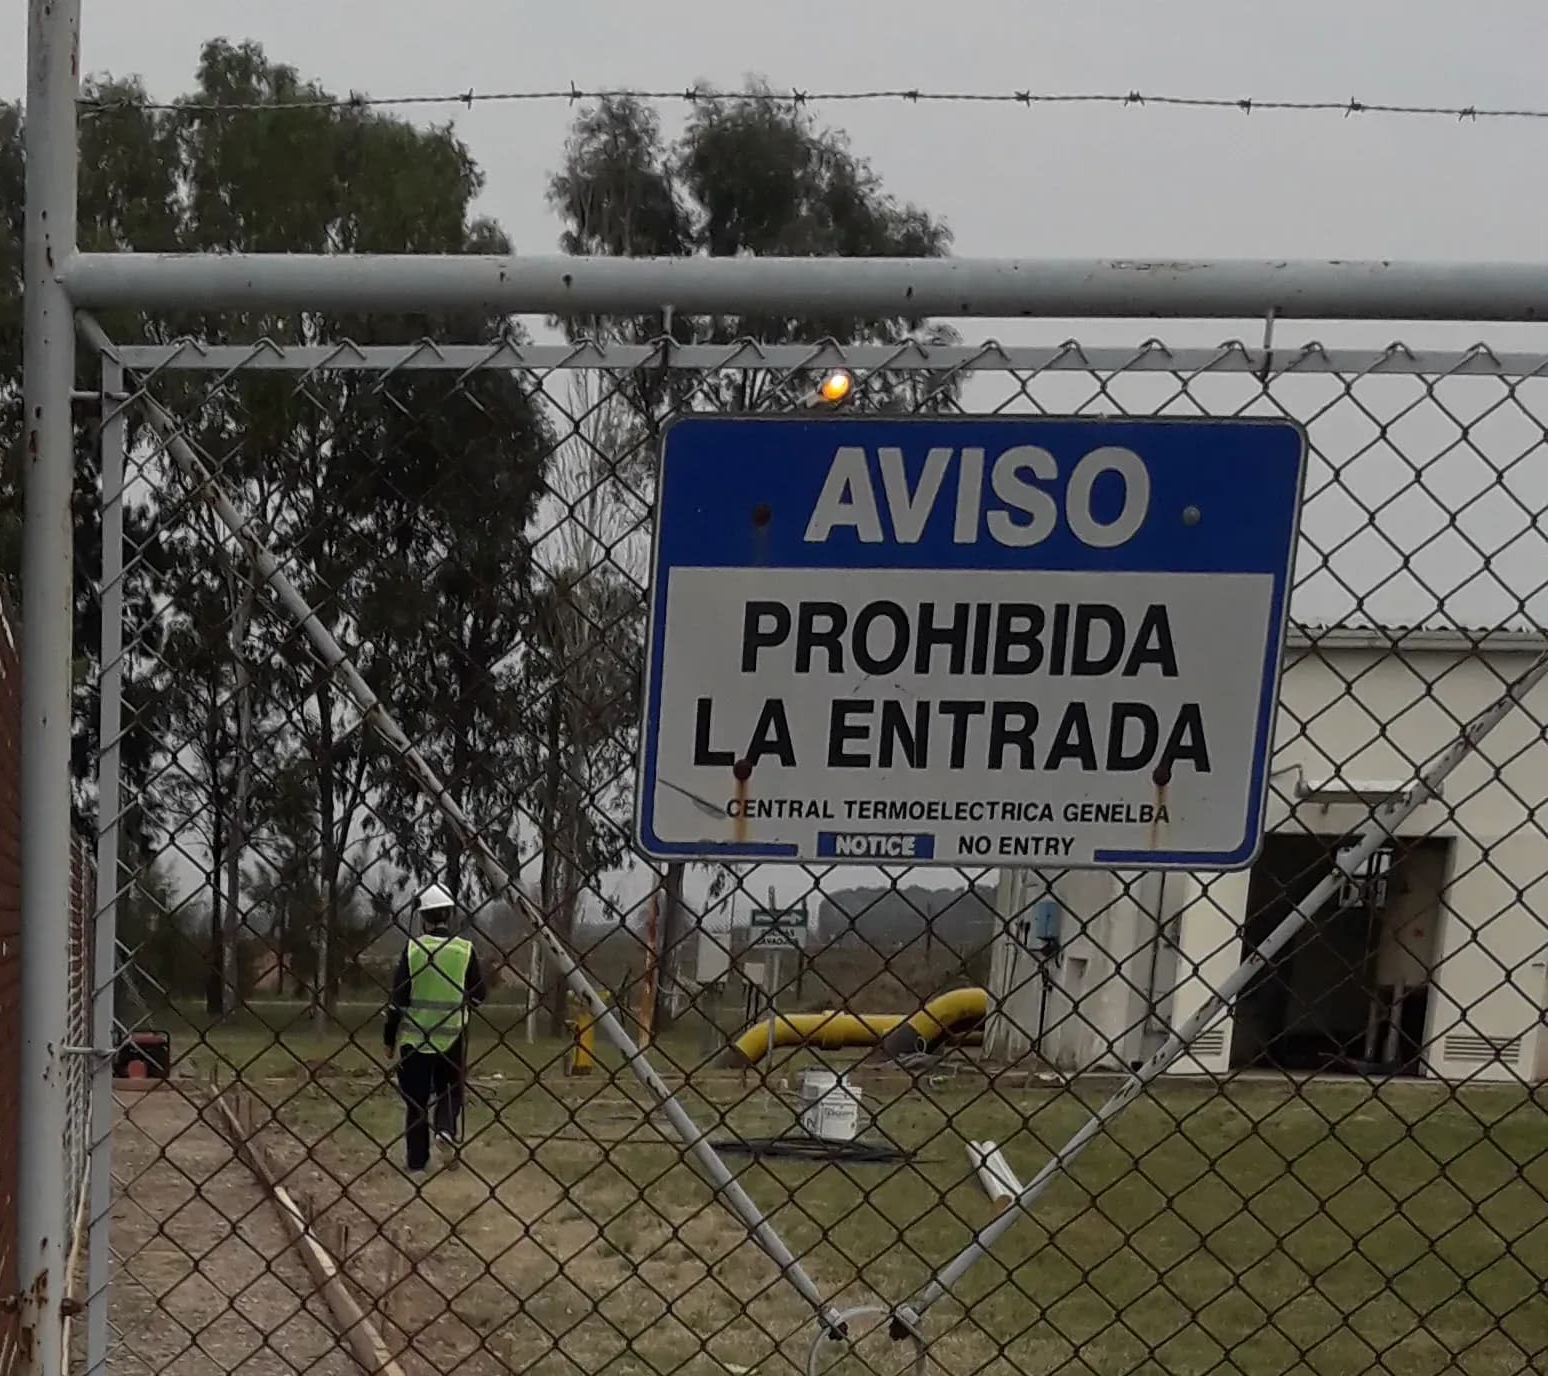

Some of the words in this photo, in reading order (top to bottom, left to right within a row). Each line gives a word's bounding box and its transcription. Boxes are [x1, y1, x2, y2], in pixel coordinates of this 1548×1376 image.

[803, 445, 1151, 548] AVISO
[741, 600, 1179, 677] PROHIBIDA
[694, 697, 796, 768] LA
[827, 698, 1212, 773] ENTRADA
[726, 799, 834, 820] CENTRAL
[844, 800, 1054, 824] TERMOELECTRICA
[1063, 803, 1170, 824] GENELBA
[835, 834, 916, 856] NOTICE
[958, 836, 992, 855] NO
[998, 836, 1075, 856] ENTRY
